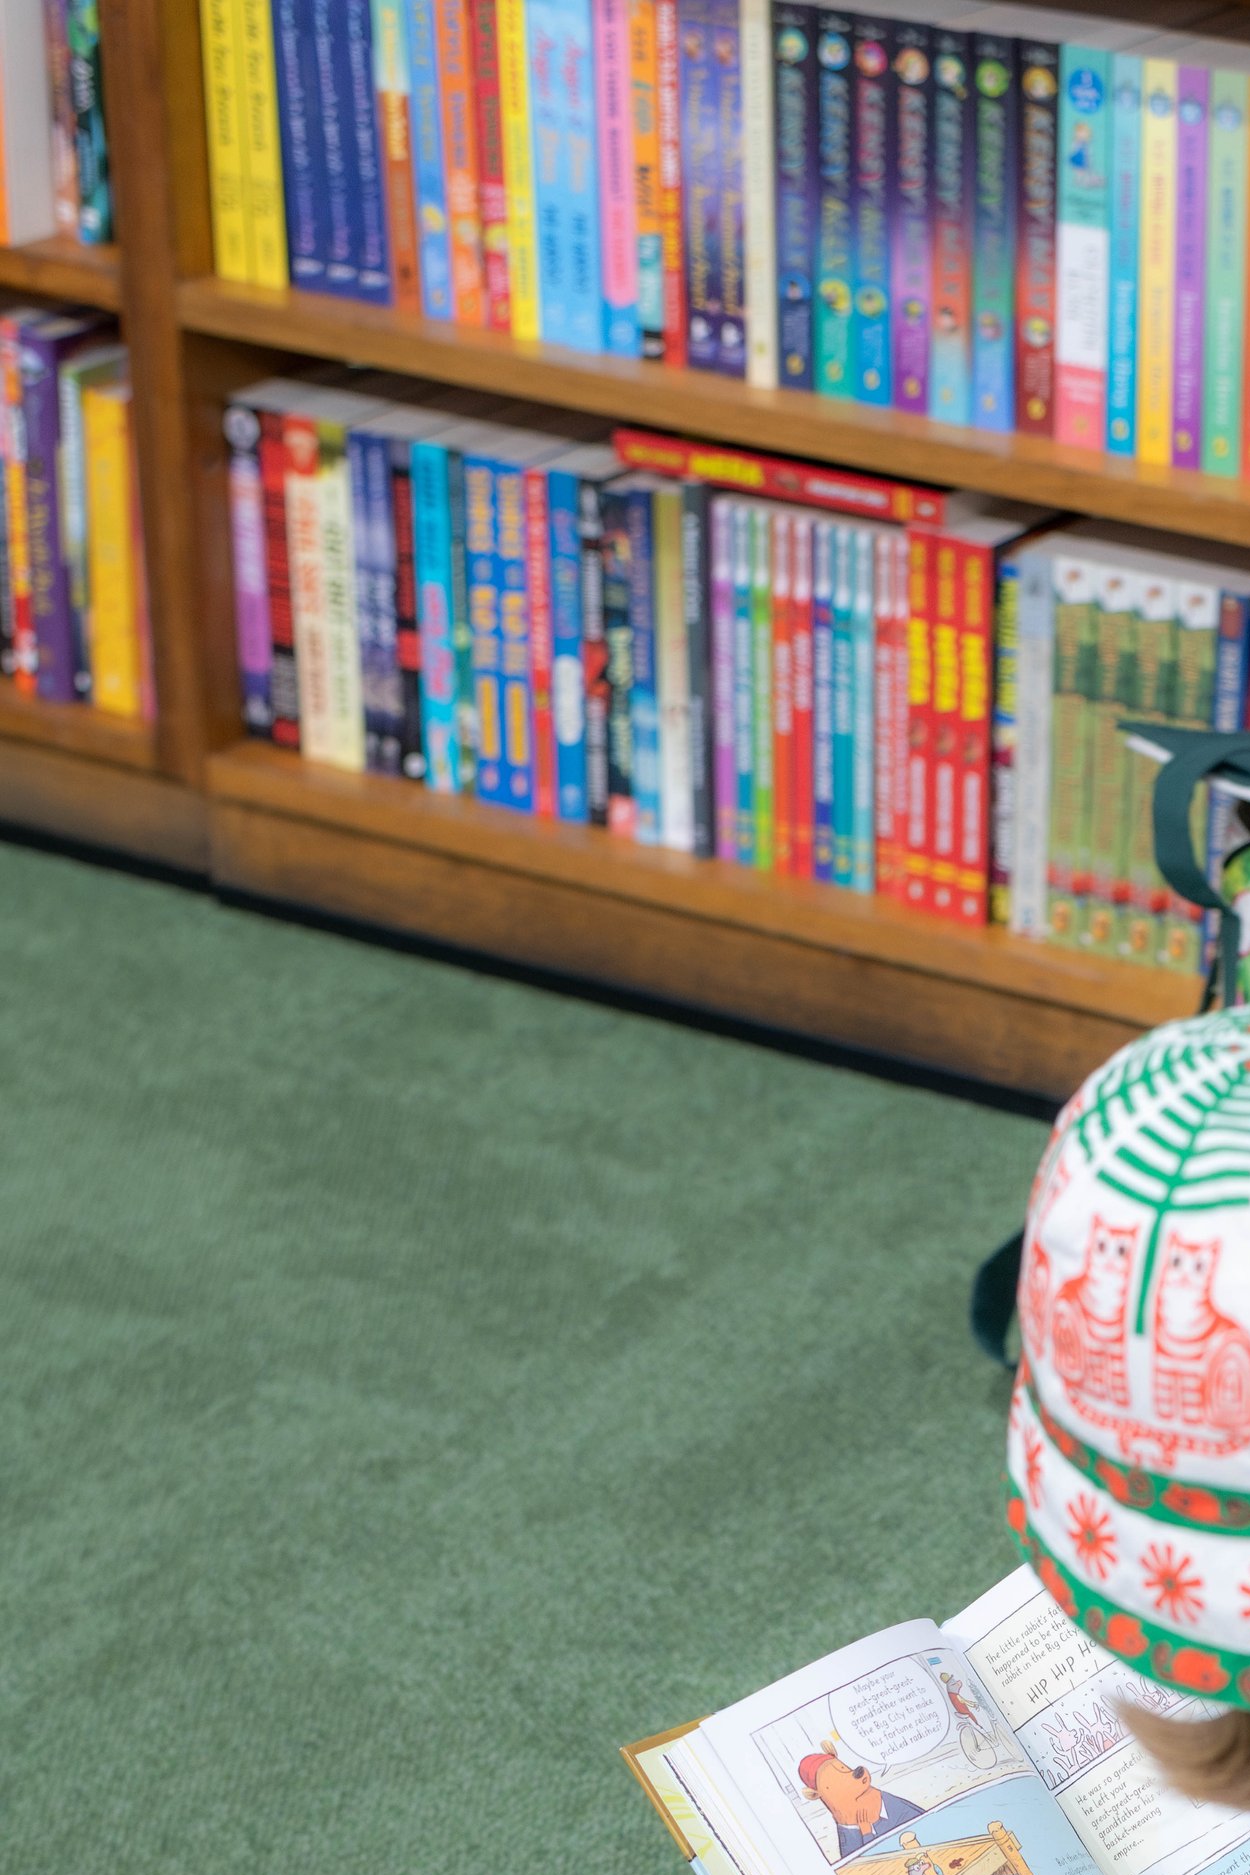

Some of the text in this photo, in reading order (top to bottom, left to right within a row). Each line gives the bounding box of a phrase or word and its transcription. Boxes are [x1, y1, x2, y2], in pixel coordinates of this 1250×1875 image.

[985, 1651, 1001, 1665] The
[1000, 1636, 1020, 1655] little
[1021, 1615, 1048, 1640] rabbit's
[992, 1618, 1067, 1677] happened to be the
[853, 1671, 895, 1695] Maybe your
[1001, 1641, 1061, 1688] rabbit in the Big
[1027, 1656, 1075, 1704] HIP HIP
[851, 1686, 927, 1729] grandfather went to
[859, 1727, 873, 1739] the
[873, 1718, 889, 1730] Big
[888, 1710, 908, 1724] City
[916, 1698, 935, 1710] make
[868, 1711, 941, 1749] his fortune selling
[880, 1737, 909, 1761] pickled
[1075, 1794, 1088, 1806] He
[1088, 1785, 1102, 1798] was
[1103, 1775, 1113, 1787] so
[1081, 1781, 1128, 1817] he left your
[1098, 1794, 1155, 1841] grandfather his
[1102, 1806, 1162, 1851] basket-weaving
